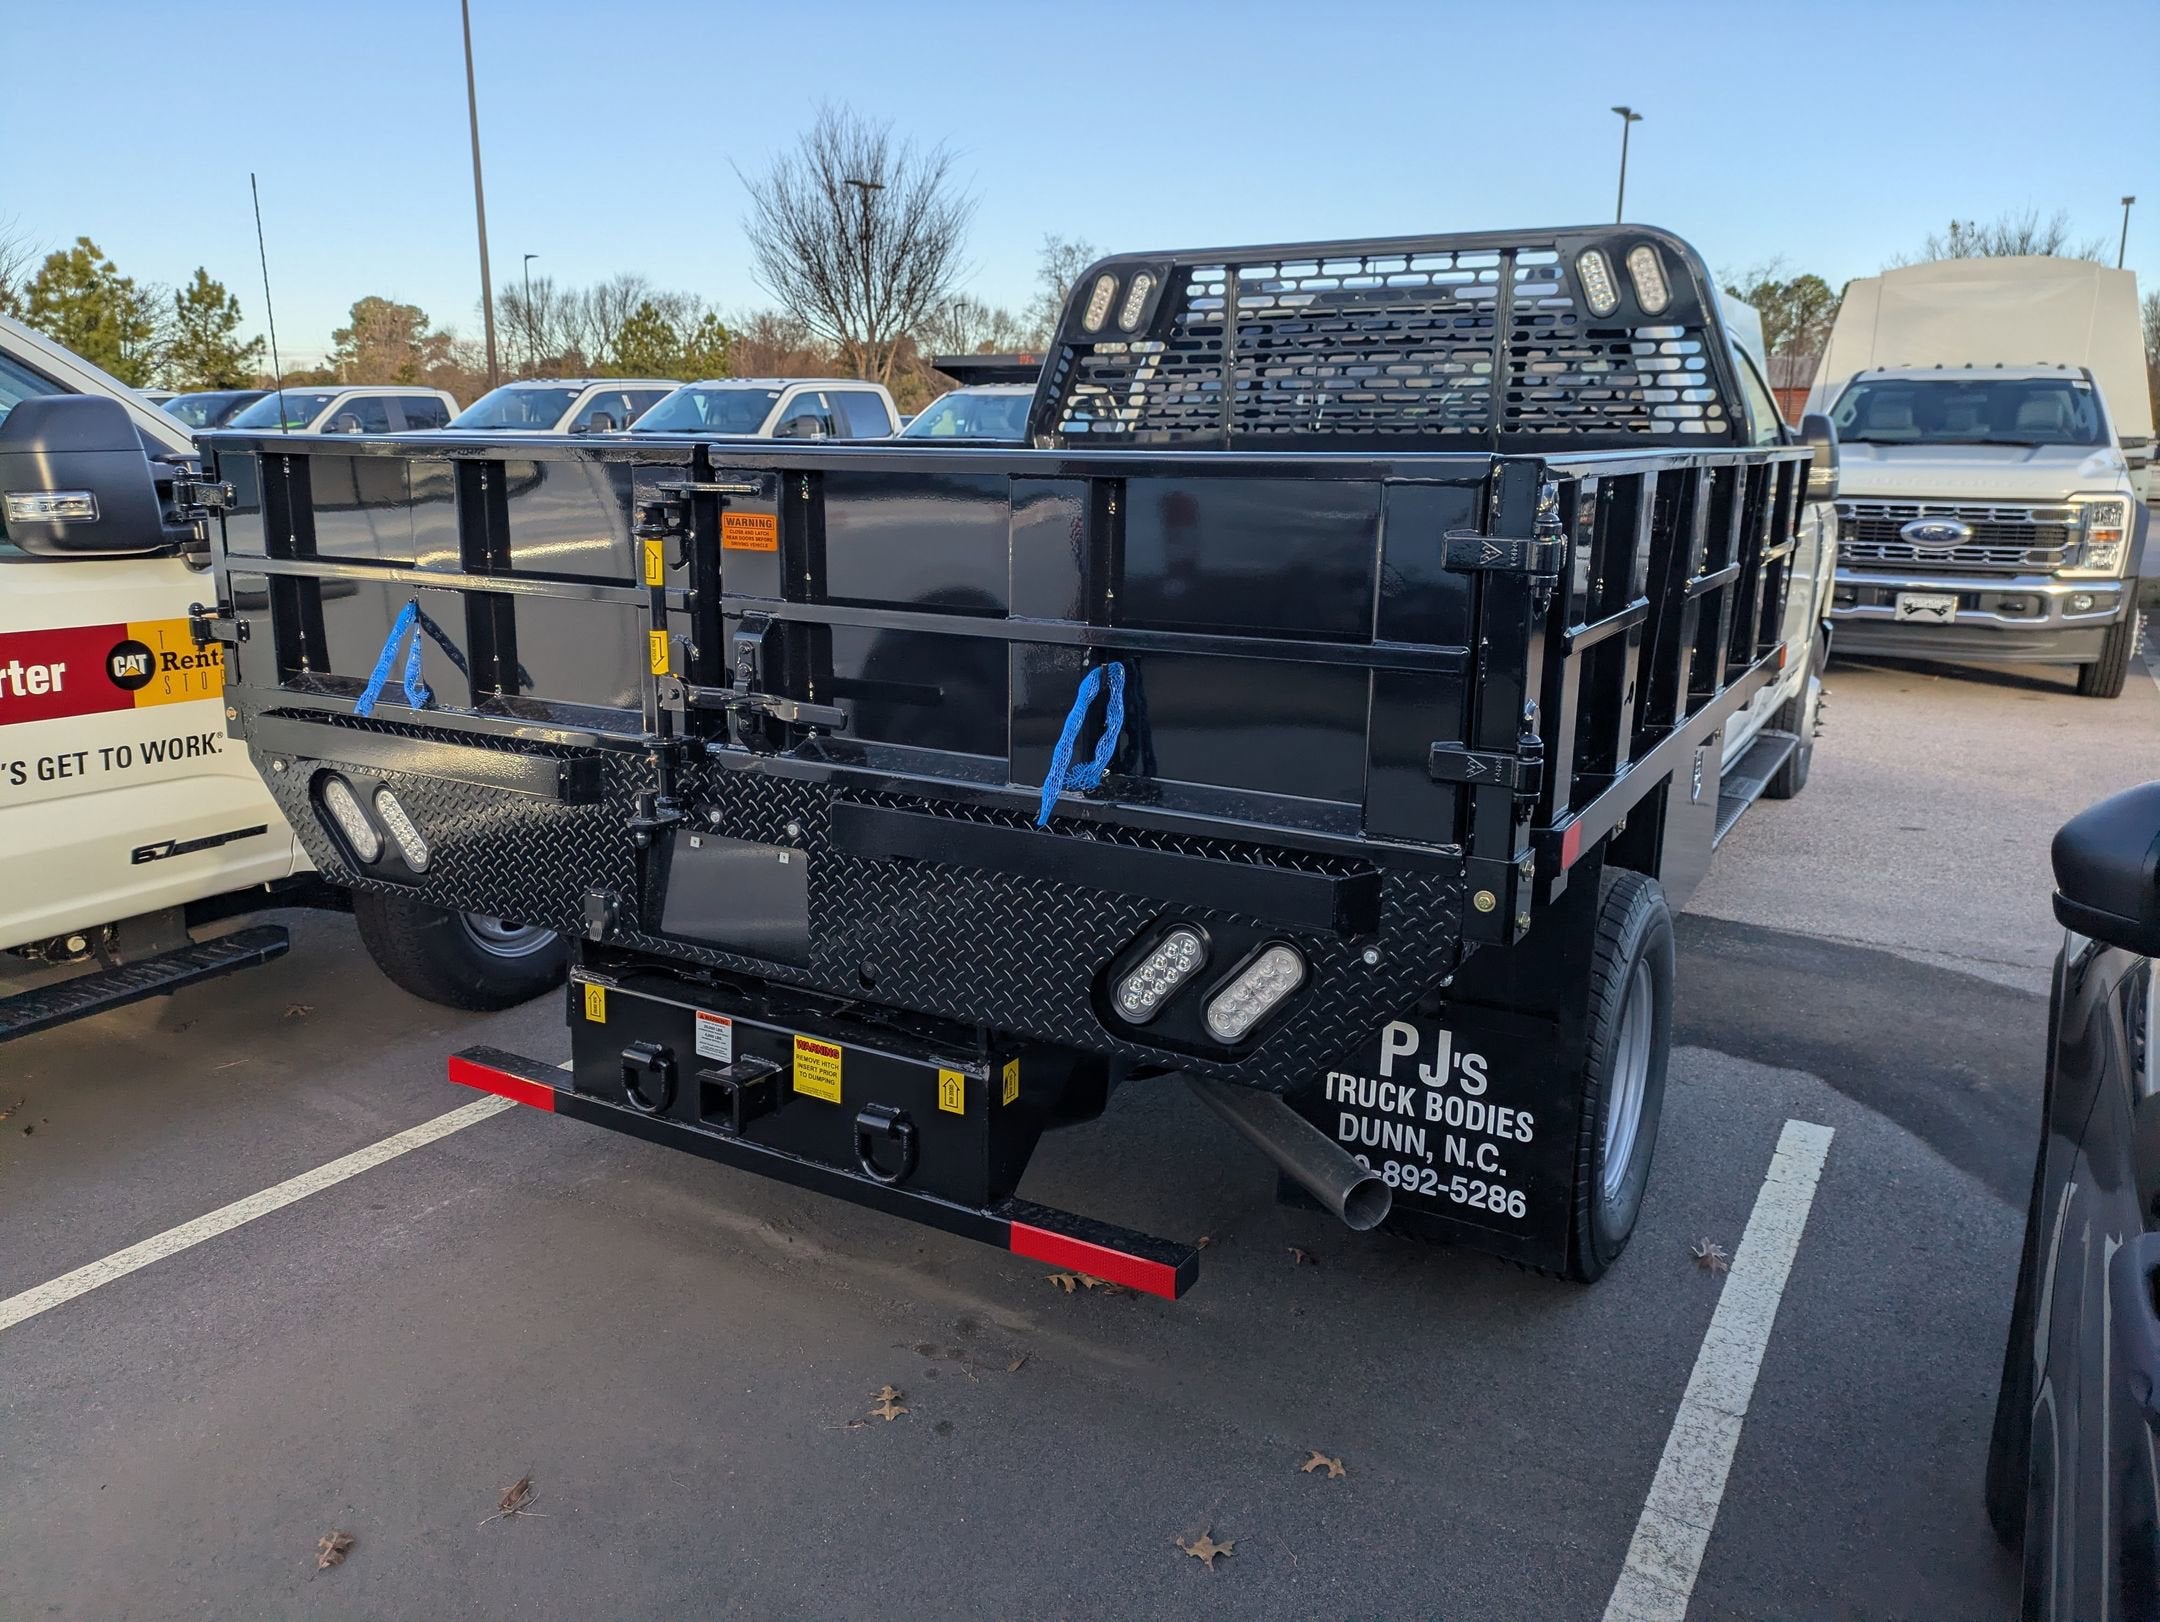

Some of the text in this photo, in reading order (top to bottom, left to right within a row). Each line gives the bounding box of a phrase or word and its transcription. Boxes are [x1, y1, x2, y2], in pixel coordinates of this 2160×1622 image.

[726, 517, 772, 528] WARNING
[113, 653, 148, 677] CAT
[160, 648, 224, 672] Rent
[37, 751, 89, 782] GET
[98, 745, 132, 772] TO
[796, 1039, 840, 1060] WARNING
[796, 1053, 839, 1070] REMOVE HITCH
[797, 1062, 838, 1078] INSERT PRIOR
[799, 1070, 835, 1086] TO DUMPING
[1325, 1071, 1534, 1143] TRUCK BODIES
[1338, 1111, 1507, 1177] DUNN, N.C.
